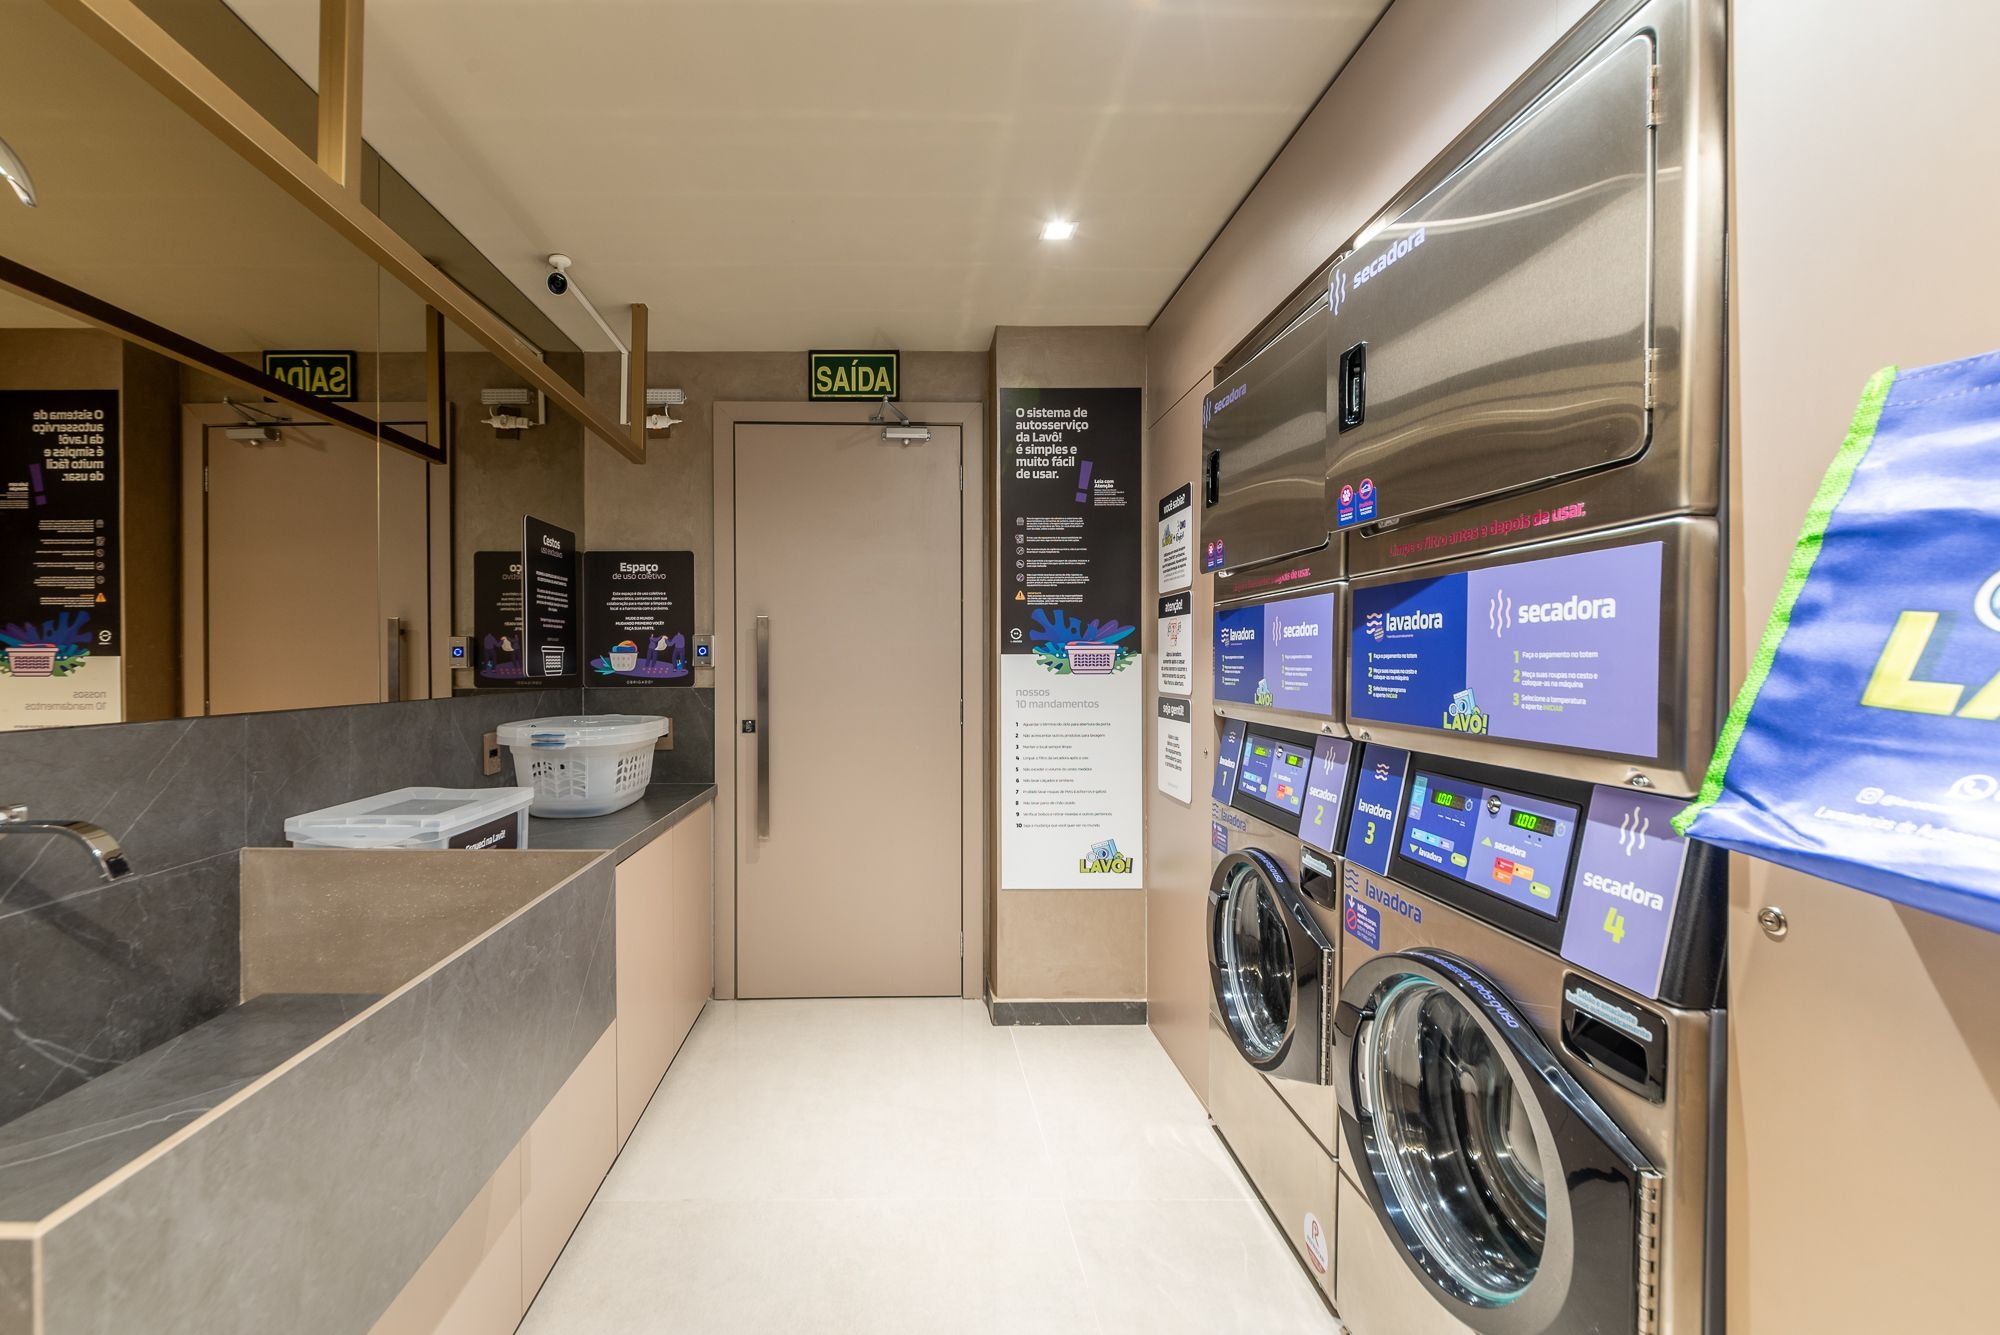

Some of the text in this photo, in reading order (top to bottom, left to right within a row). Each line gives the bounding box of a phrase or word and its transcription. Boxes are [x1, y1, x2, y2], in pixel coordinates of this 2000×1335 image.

[1353, 227, 1425, 290] secadora
[816, 360, 892, 392] SAÍDA
[1214, 384, 1246, 414] secadora
[1016, 408, 1087, 418] O sistema de
[1016, 420, 1089, 432] autosserviço
[1016, 432, 1062, 442] da Lavô!
[1016, 444, 1023, 454] é
[1025, 445, 1068, 456] simples
[1016, 456, 1074, 466] muito fácil
[1016, 469, 1059, 478] de usar.
[1449, 530, 1479, 544] antes
[1489, 514, 1530, 535] depois
[1533, 509, 1549, 525] de
[1552, 502, 1586, 521] usar.
[543, 535, 560, 550] Cestos
[620, 562, 658, 574] Espaço
[1518, 594, 1616, 624] secadora
[1386, 610, 1443, 631] lavadora
[1230, 627, 1254, 641] lavadora
[1283, 621, 1318, 638] secadora
[1368, 653, 1372, 663] 1
[1514, 650, 1519, 663] 1
[1368, 667, 1372, 677] 2
[1513, 670, 1520, 683] 2
[1368, 684, 1372, 695] 3
[1016, 700, 1100, 709] 10 mandamentos
[1513, 693, 1519, 706] 3
[1442, 706, 1489, 735] LAVÔ!
[1222, 771, 1227, 786] 1
[1309, 786, 1337, 803] secadora
[1314, 805, 1323, 825] 2
[1358, 798, 1392, 821] lavadora
[1221, 807, 1246, 831] lavadora
[1364, 821, 1376, 845] 3
[1418, 847, 1443, 863] lavadora
[1493, 841, 1526, 858] secadora
[1080, 852, 1133, 873] LAVÔ!
[1583, 871, 1664, 911] secadora
[1365, 879, 1422, 924] lavadora
[1603, 907, 1625, 944] 4
[1496, 1007, 1520, 1028] USO
